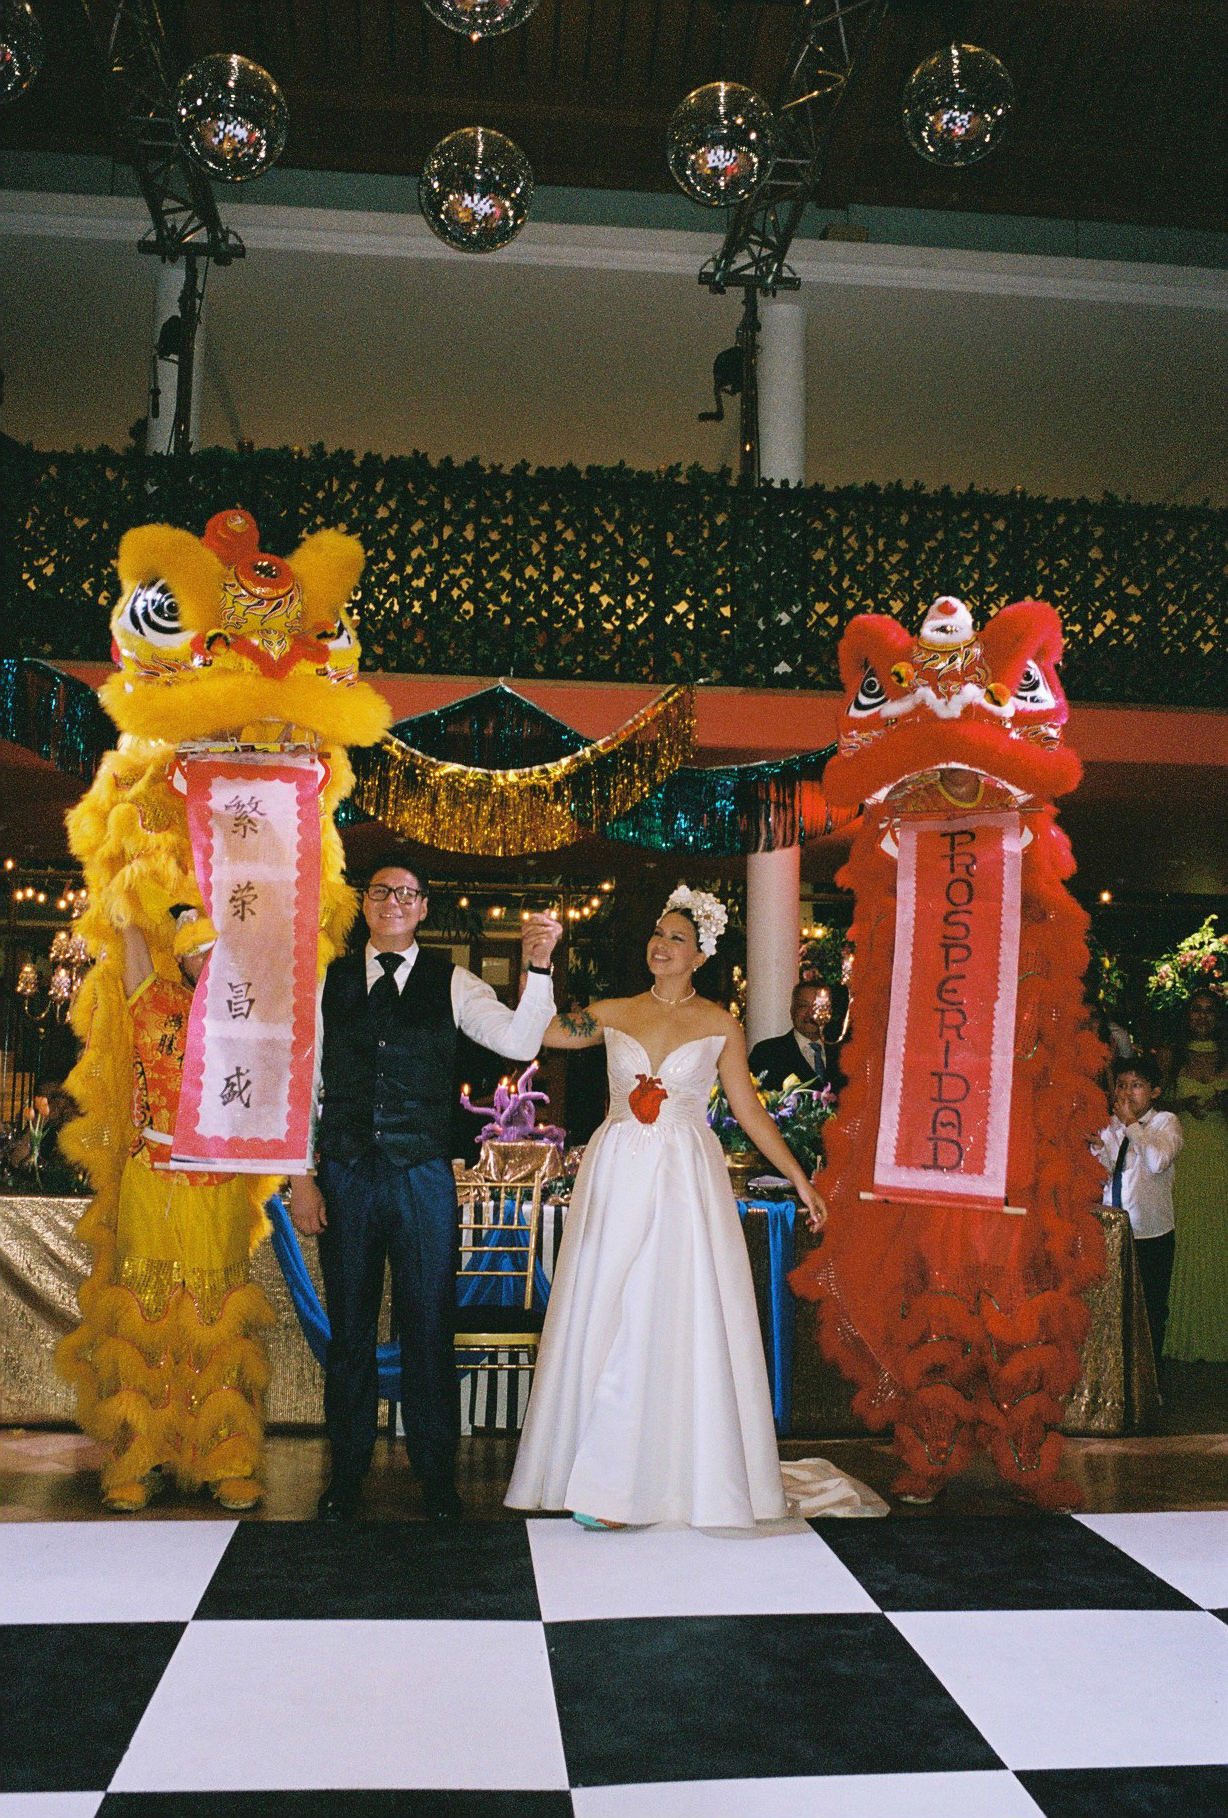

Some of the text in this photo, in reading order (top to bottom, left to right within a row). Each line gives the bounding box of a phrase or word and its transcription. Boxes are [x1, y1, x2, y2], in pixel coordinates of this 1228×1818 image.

[219, 795, 267, 1109] 繁荣昌盛
[922, 830, 977, 1172] PROSPERIDAD
